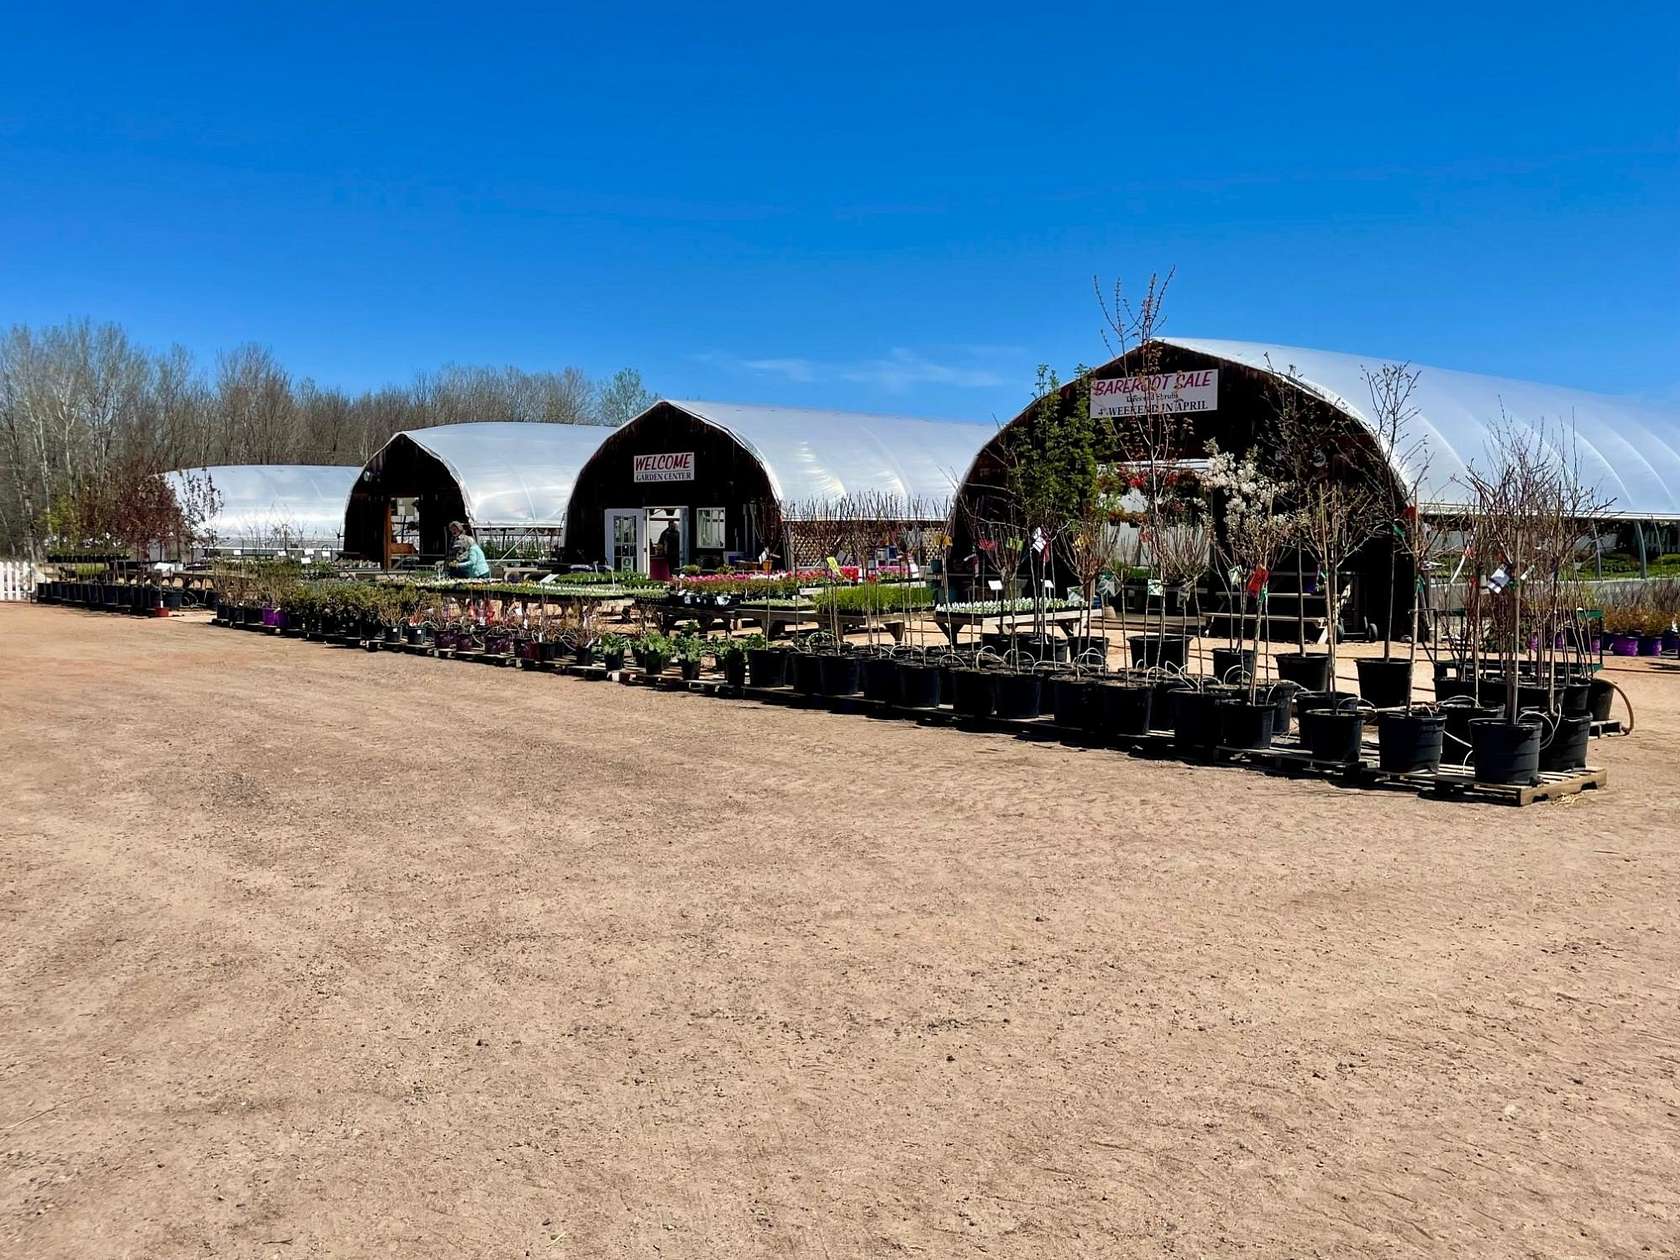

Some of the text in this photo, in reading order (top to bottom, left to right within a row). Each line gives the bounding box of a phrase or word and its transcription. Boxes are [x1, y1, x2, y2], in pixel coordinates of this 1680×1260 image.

[1173, 370, 1212, 390] SALE
[1174, 400, 1209, 412] APRIL
[636, 453, 692, 471] WELCOME
[636, 471, 692, 481] GARDEN CENTER
